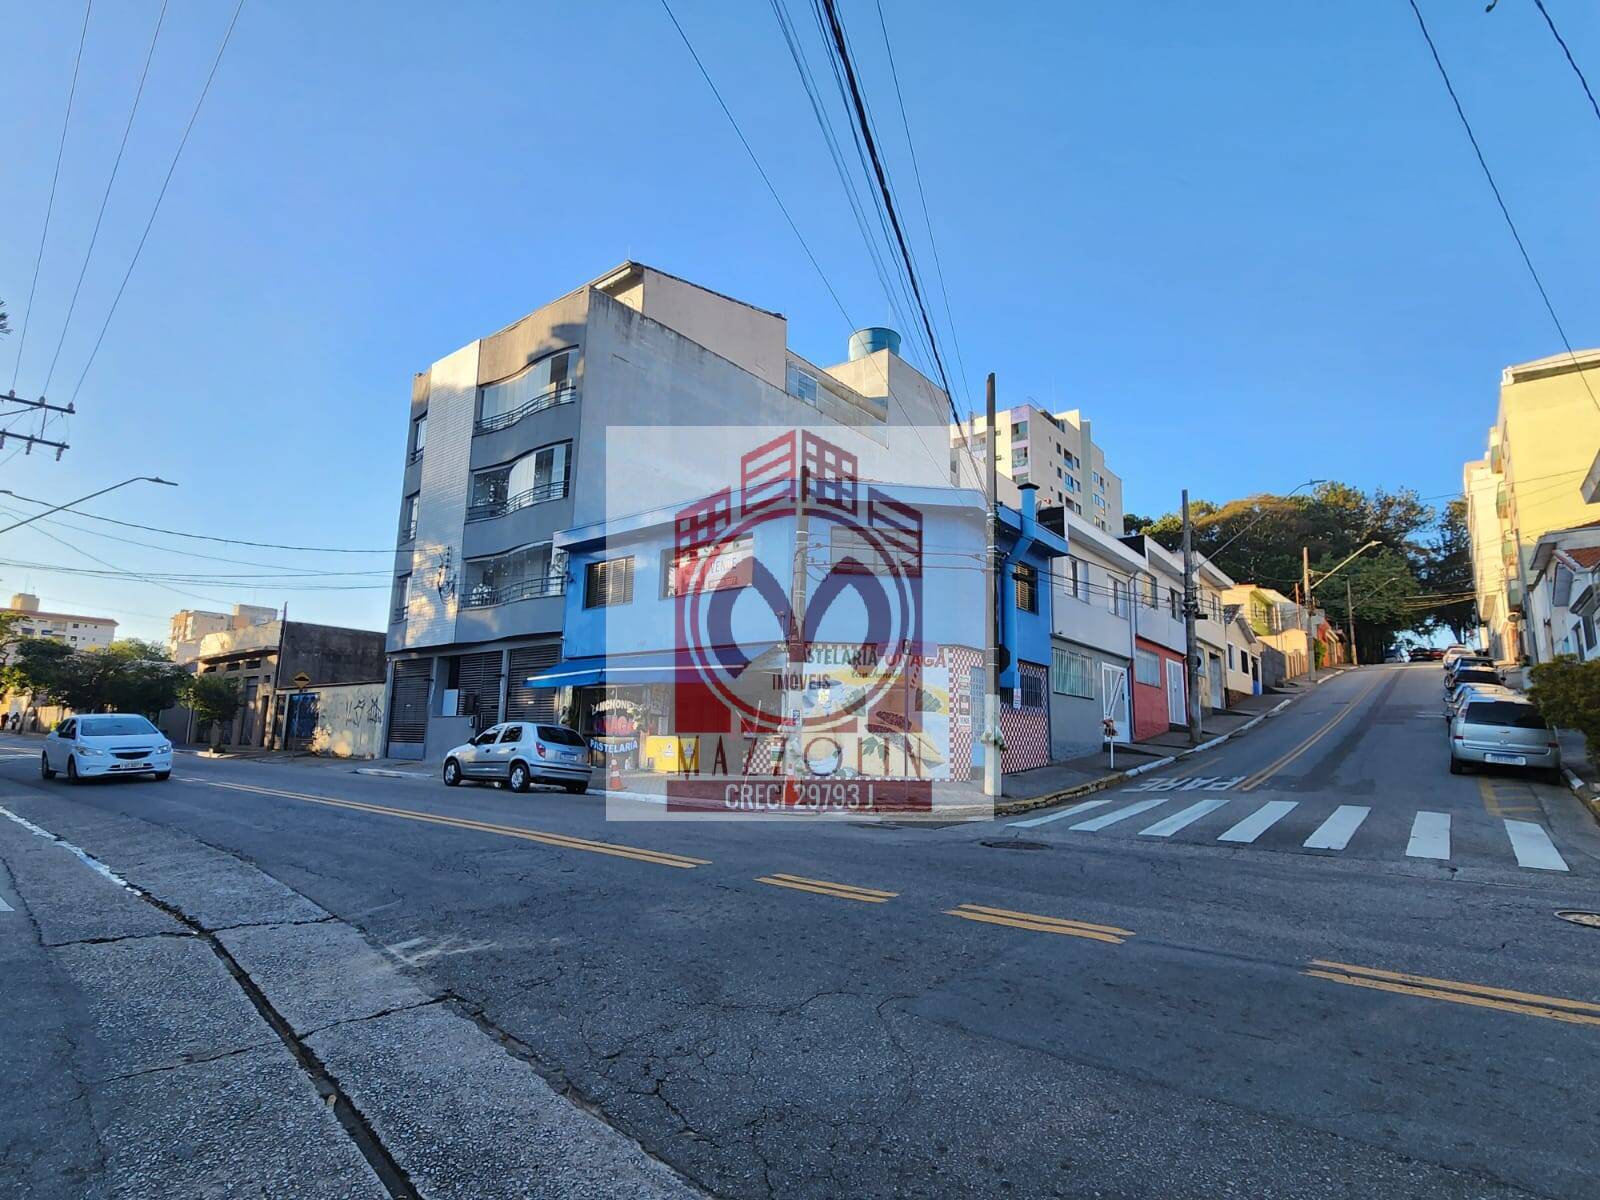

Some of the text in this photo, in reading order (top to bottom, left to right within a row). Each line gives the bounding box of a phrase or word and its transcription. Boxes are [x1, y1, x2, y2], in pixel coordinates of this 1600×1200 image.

[800, 646, 877, 667] ASTELARIA
[589, 738, 638, 754] PASTELARIA
[1120, 776, 1247, 792] PARE
